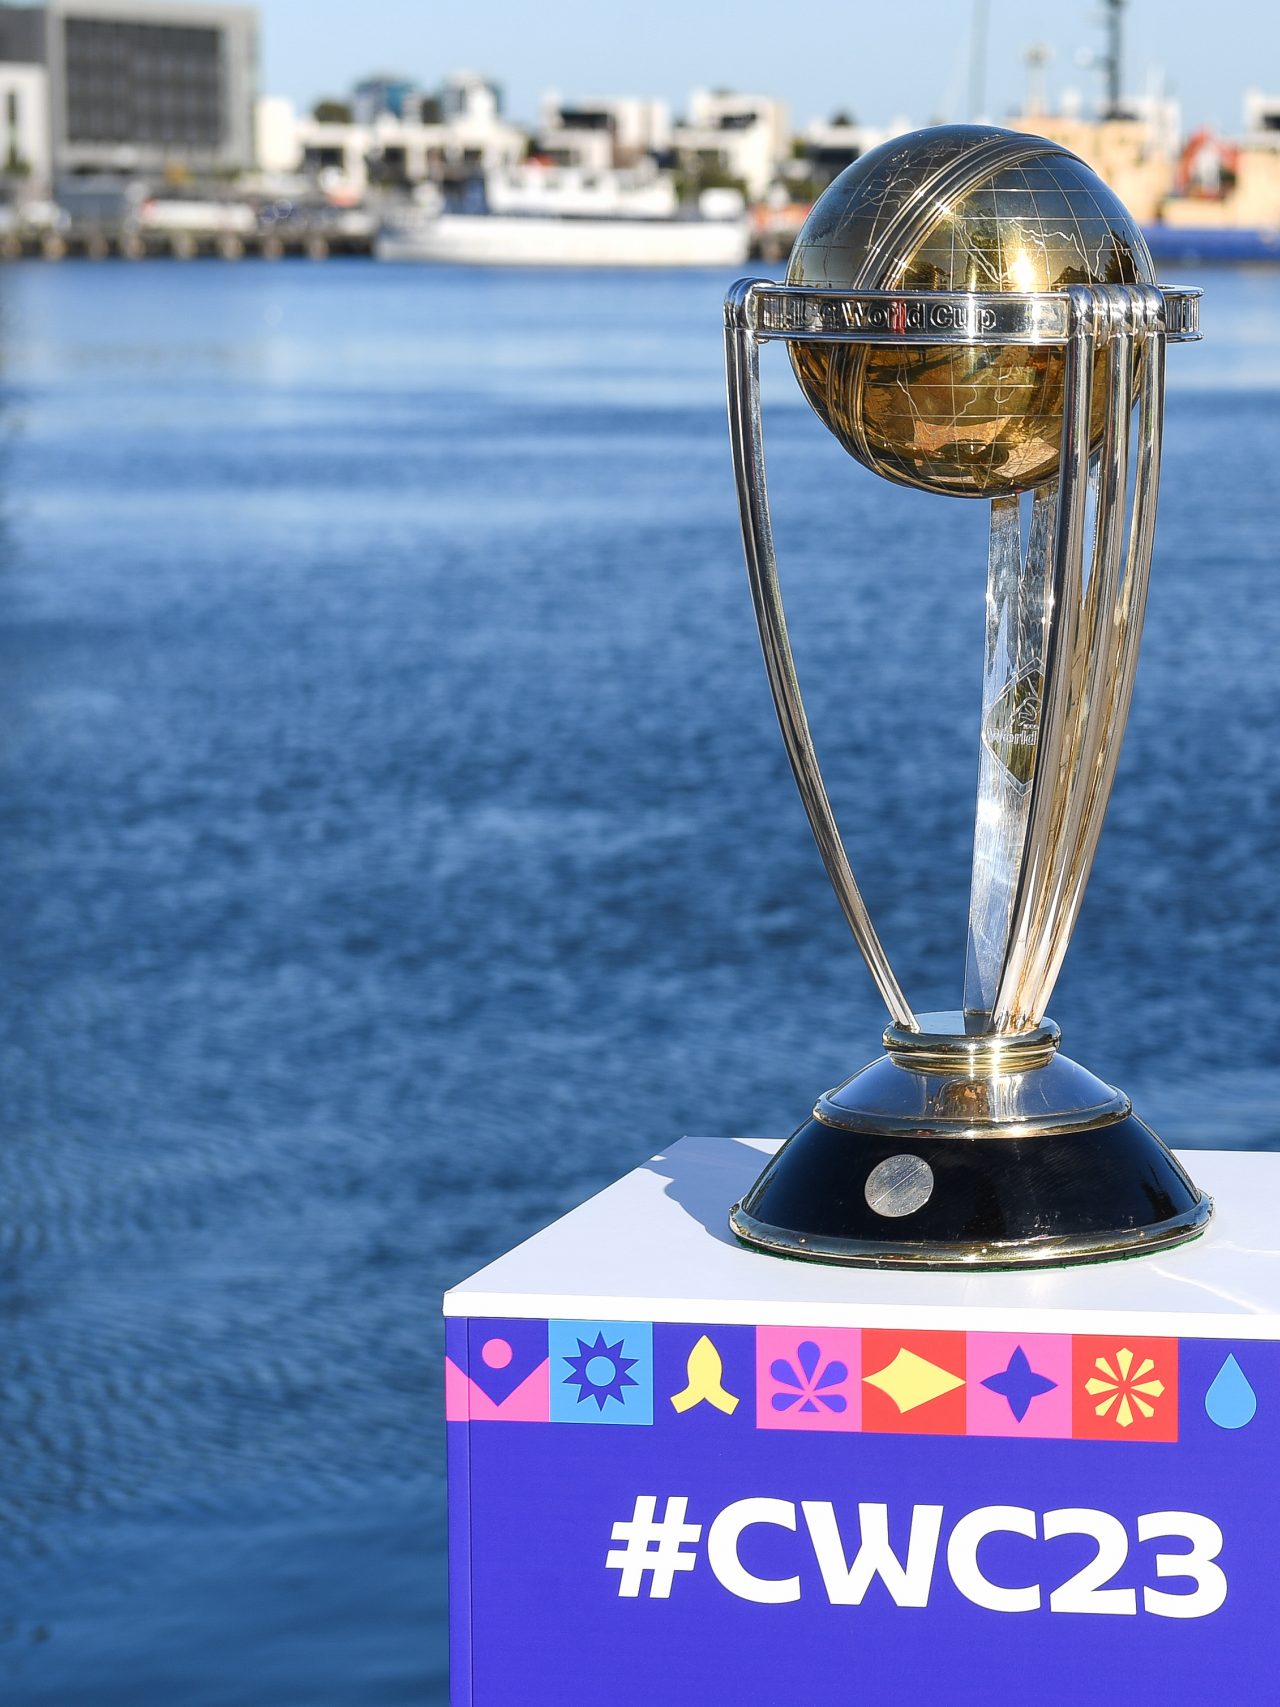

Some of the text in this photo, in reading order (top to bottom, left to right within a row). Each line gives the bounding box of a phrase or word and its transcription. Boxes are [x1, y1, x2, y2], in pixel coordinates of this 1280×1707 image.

[841, 302, 926, 328] World
[930, 304, 997, 332] Cup
[605, 1495, 1228, 1619] #CWC23
